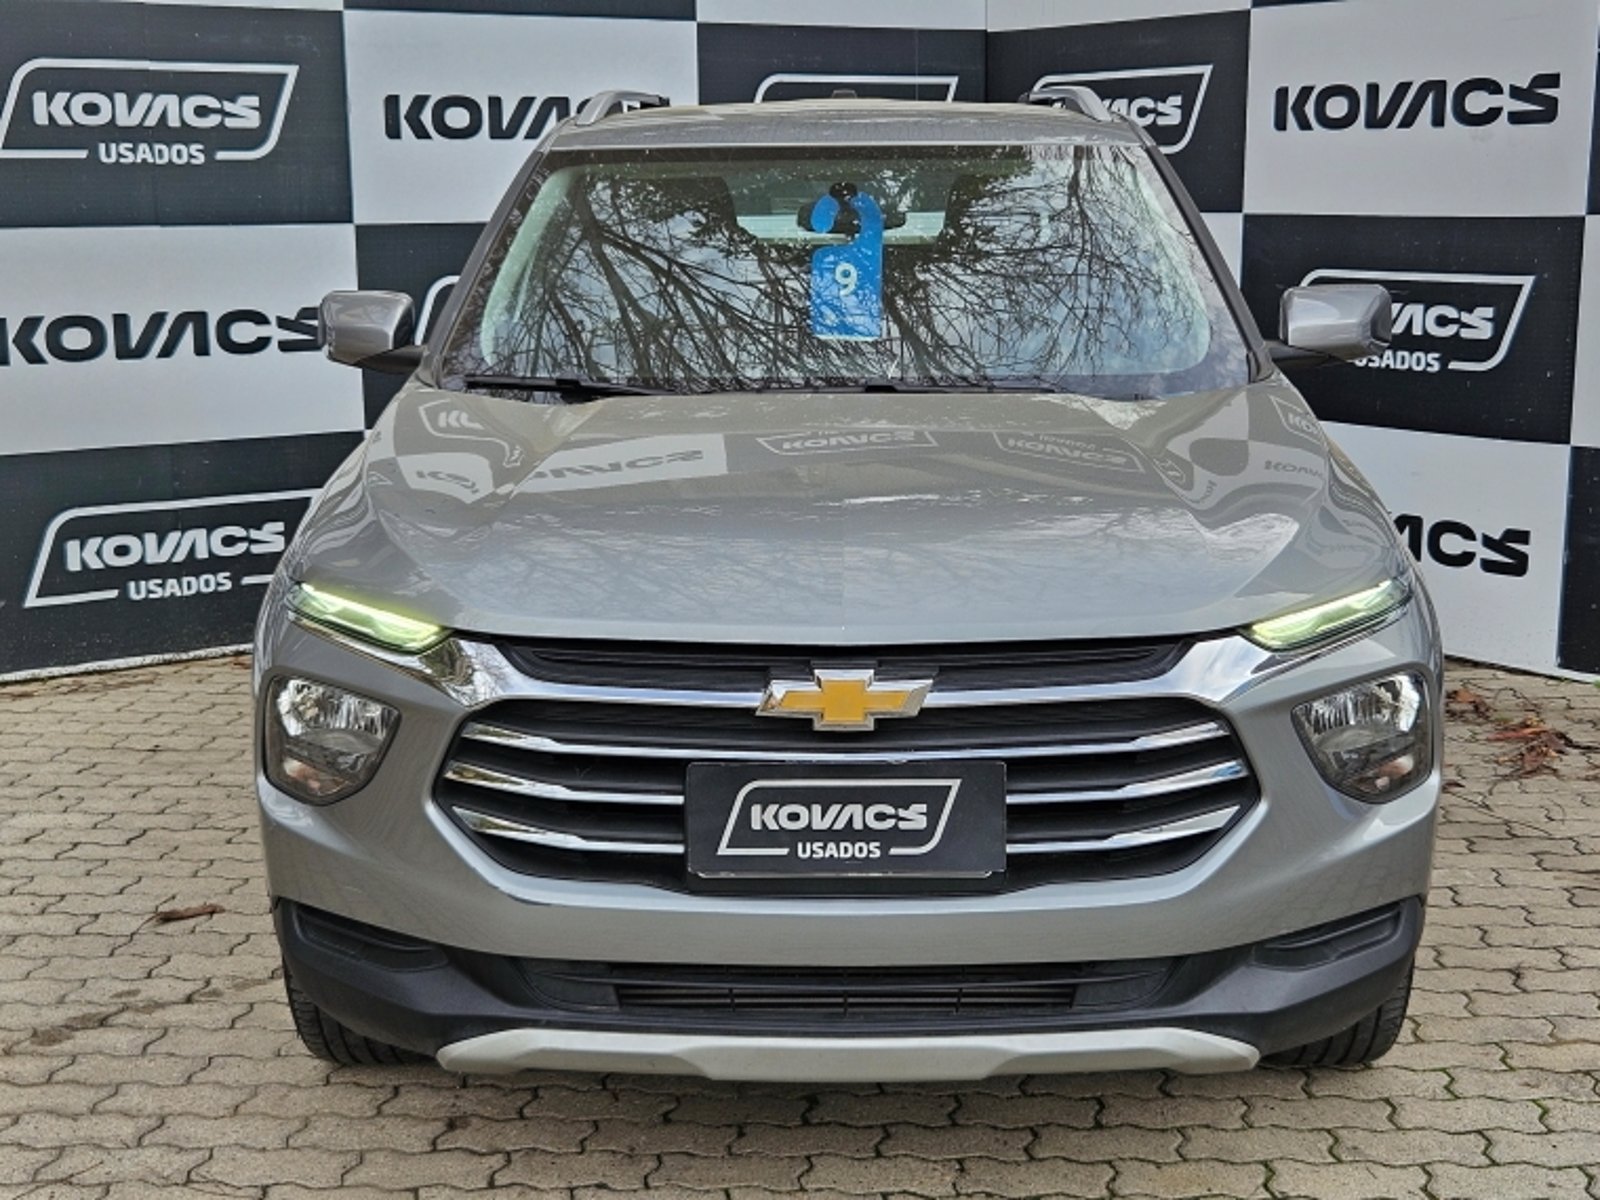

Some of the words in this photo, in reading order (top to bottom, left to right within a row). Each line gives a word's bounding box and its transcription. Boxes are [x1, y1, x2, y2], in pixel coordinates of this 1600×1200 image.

[32, 91, 260, 129] KOVACS
[1273, 72, 1561, 132] KOVACS
[98, 142, 206, 166] USADOS
[835, 262, 858, 296] 9
[65, 521, 286, 572] KOVACS
[128, 572, 232, 600] USADOS
[750, 803, 928, 830] KOVACS
[797, 841, 881, 858] USADOS
